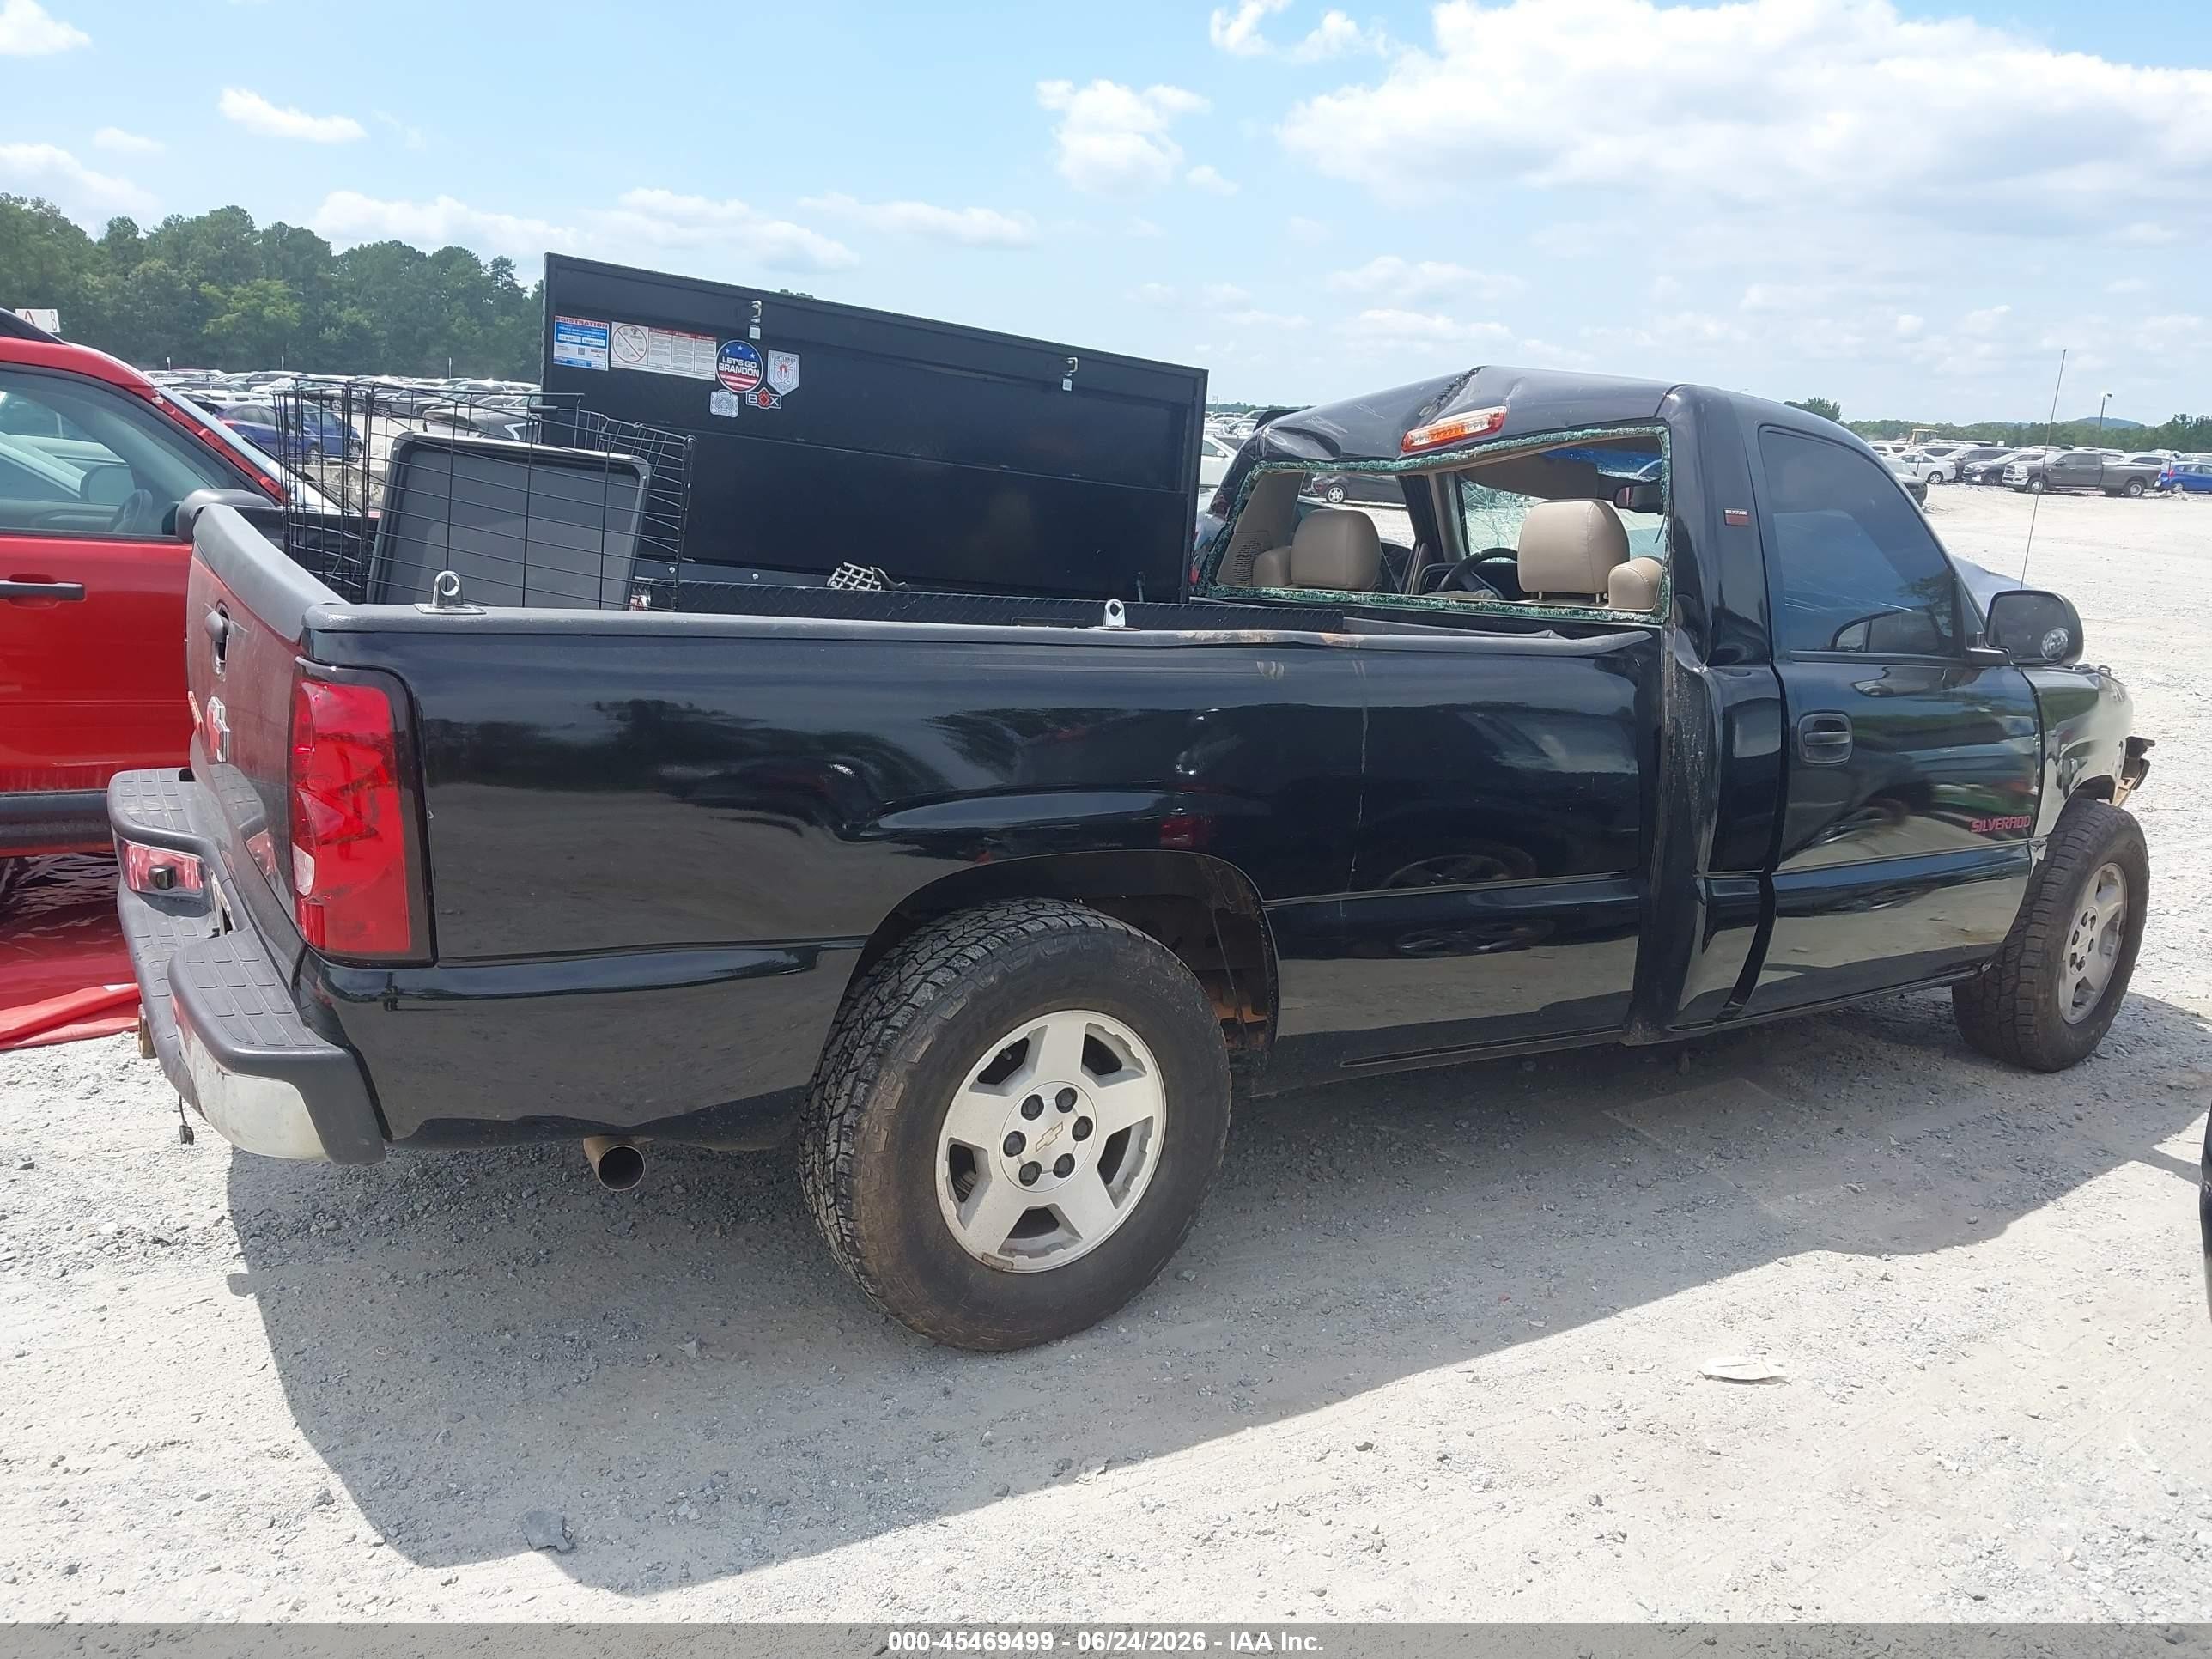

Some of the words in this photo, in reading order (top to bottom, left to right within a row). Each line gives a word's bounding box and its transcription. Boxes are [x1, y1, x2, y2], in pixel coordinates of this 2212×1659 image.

[50, 310, 58, 331] B
[718, 362, 760, 378] BRANDON
[722, 356, 744, 366] LET'S
[744, 360, 757, 368] GO
[1971, 815, 2032, 833] SILVERADO
